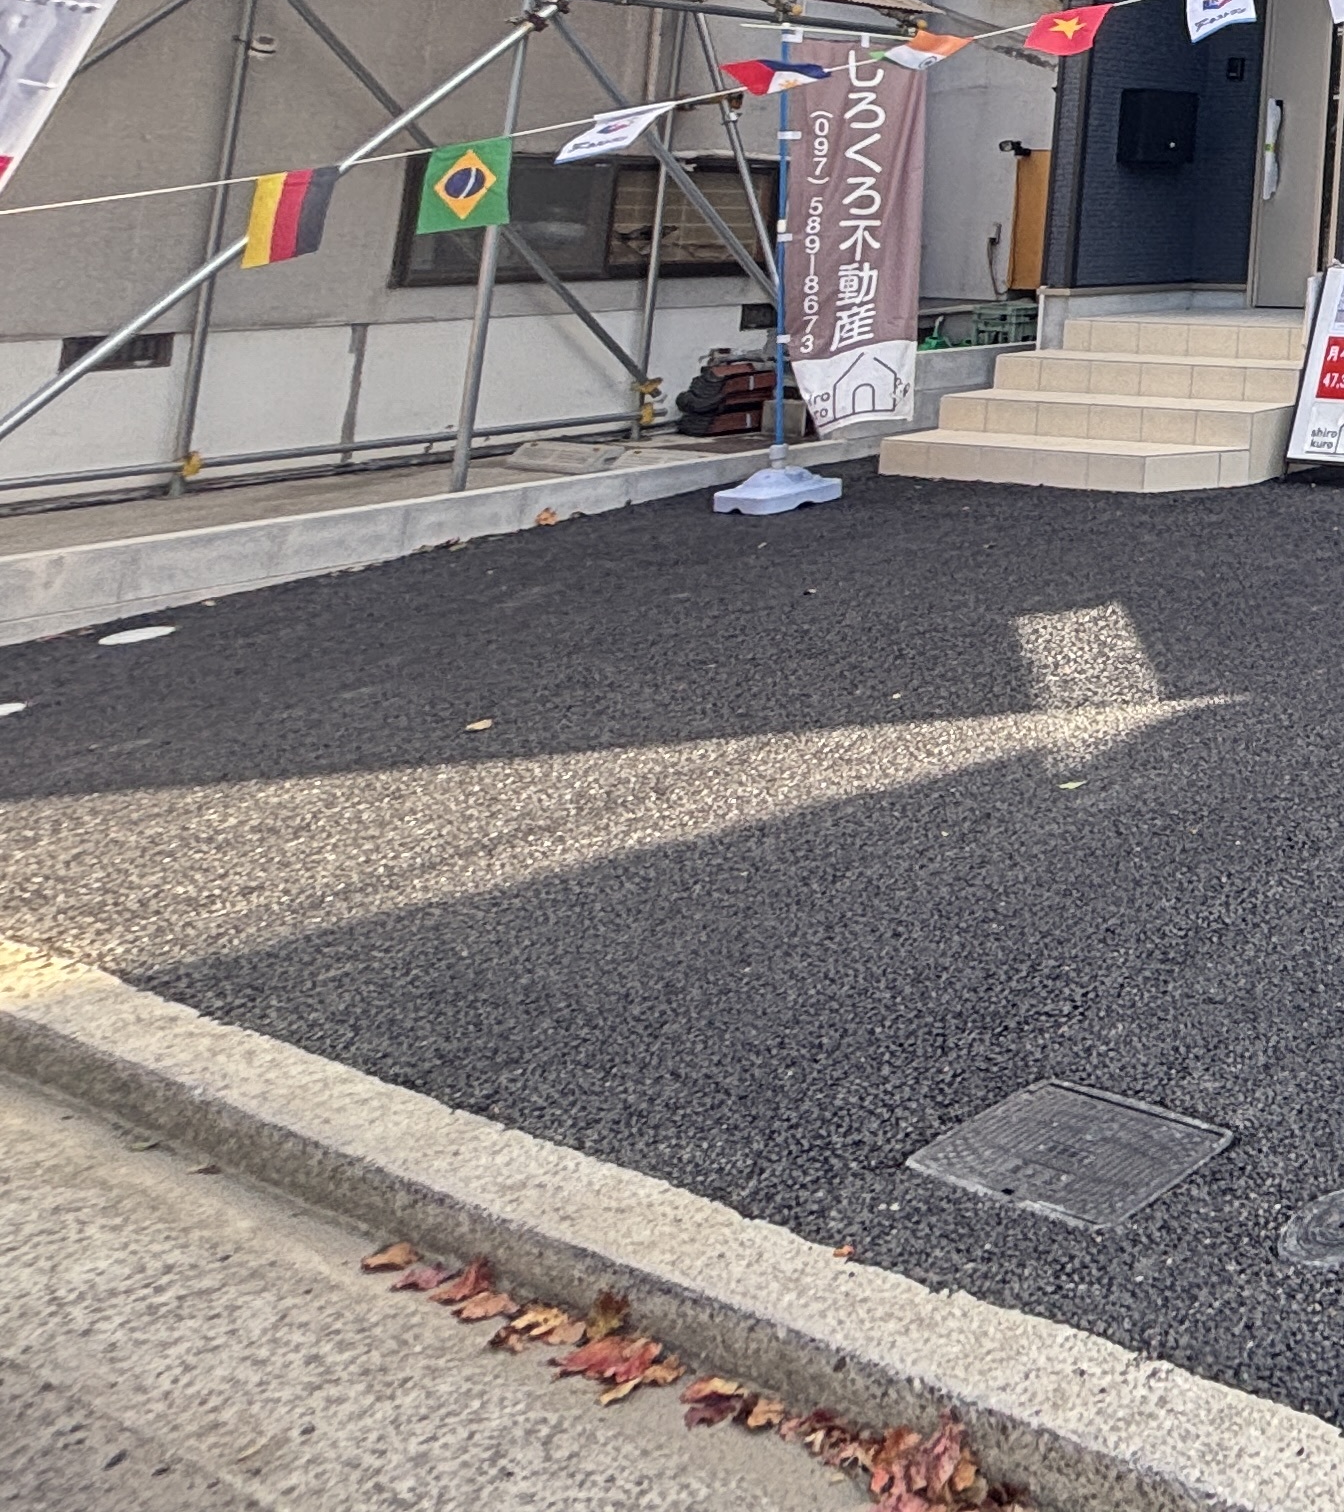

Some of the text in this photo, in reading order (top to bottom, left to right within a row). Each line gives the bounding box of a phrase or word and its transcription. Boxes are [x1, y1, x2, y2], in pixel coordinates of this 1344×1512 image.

[830, 49, 886, 352] しろくろ不動産
[1311, 427, 1338, 439] shiro
[1310, 438, 1334, 450] kuro
